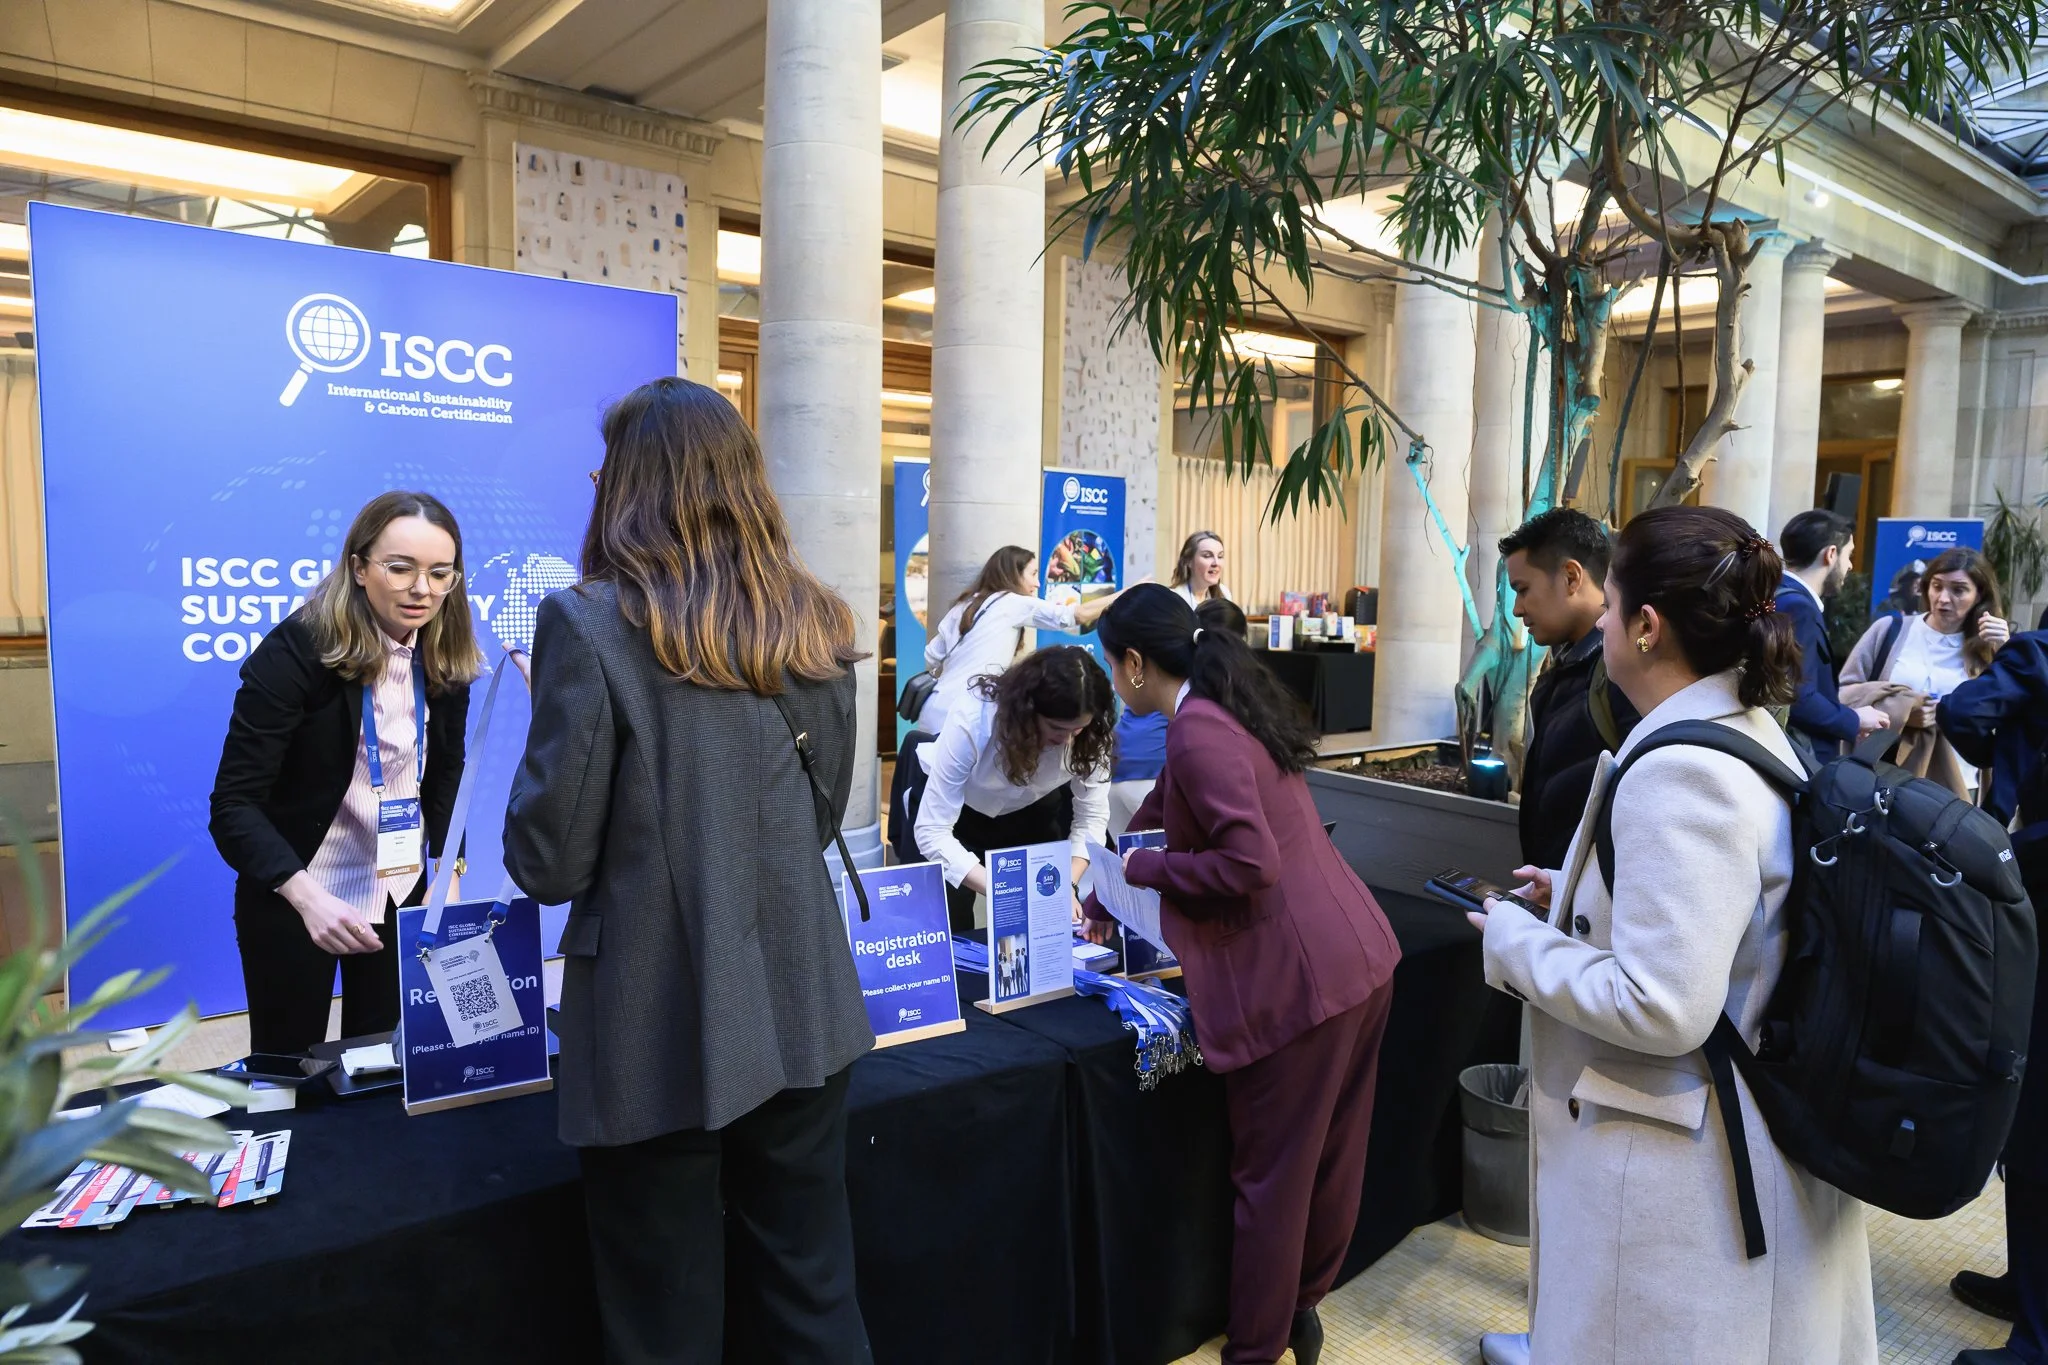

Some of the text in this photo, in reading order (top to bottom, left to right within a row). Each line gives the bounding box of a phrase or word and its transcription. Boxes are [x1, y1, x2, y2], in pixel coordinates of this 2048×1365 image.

[380, 331, 513, 387] ISCC
[327, 383, 513, 413] International Sustainability
[364, 401, 513, 424] & Carbon Certification
[1080, 487, 1108, 504] ISCC
[1927, 531, 1957, 542] ISCC
[181, 557, 280, 588] ISCC
[1007, 858, 1022, 867] ISCC
[994, 881, 1007, 889] ISCC
[994, 886, 1023, 896] Association
[855, 930, 947, 957] Registration
[886, 950, 922, 969] desk
[862, 974, 951, 997] Please collect your name ID)
[907, 1008, 921, 1017] ISCC
[482, 1018, 499, 1028] ISCC
[501, 1030, 525, 1040] name
[527, 1025, 540, 1035] ID)
[412, 1043, 445, 1055] (Please
[475, 1066, 495, 1076] ISCC
